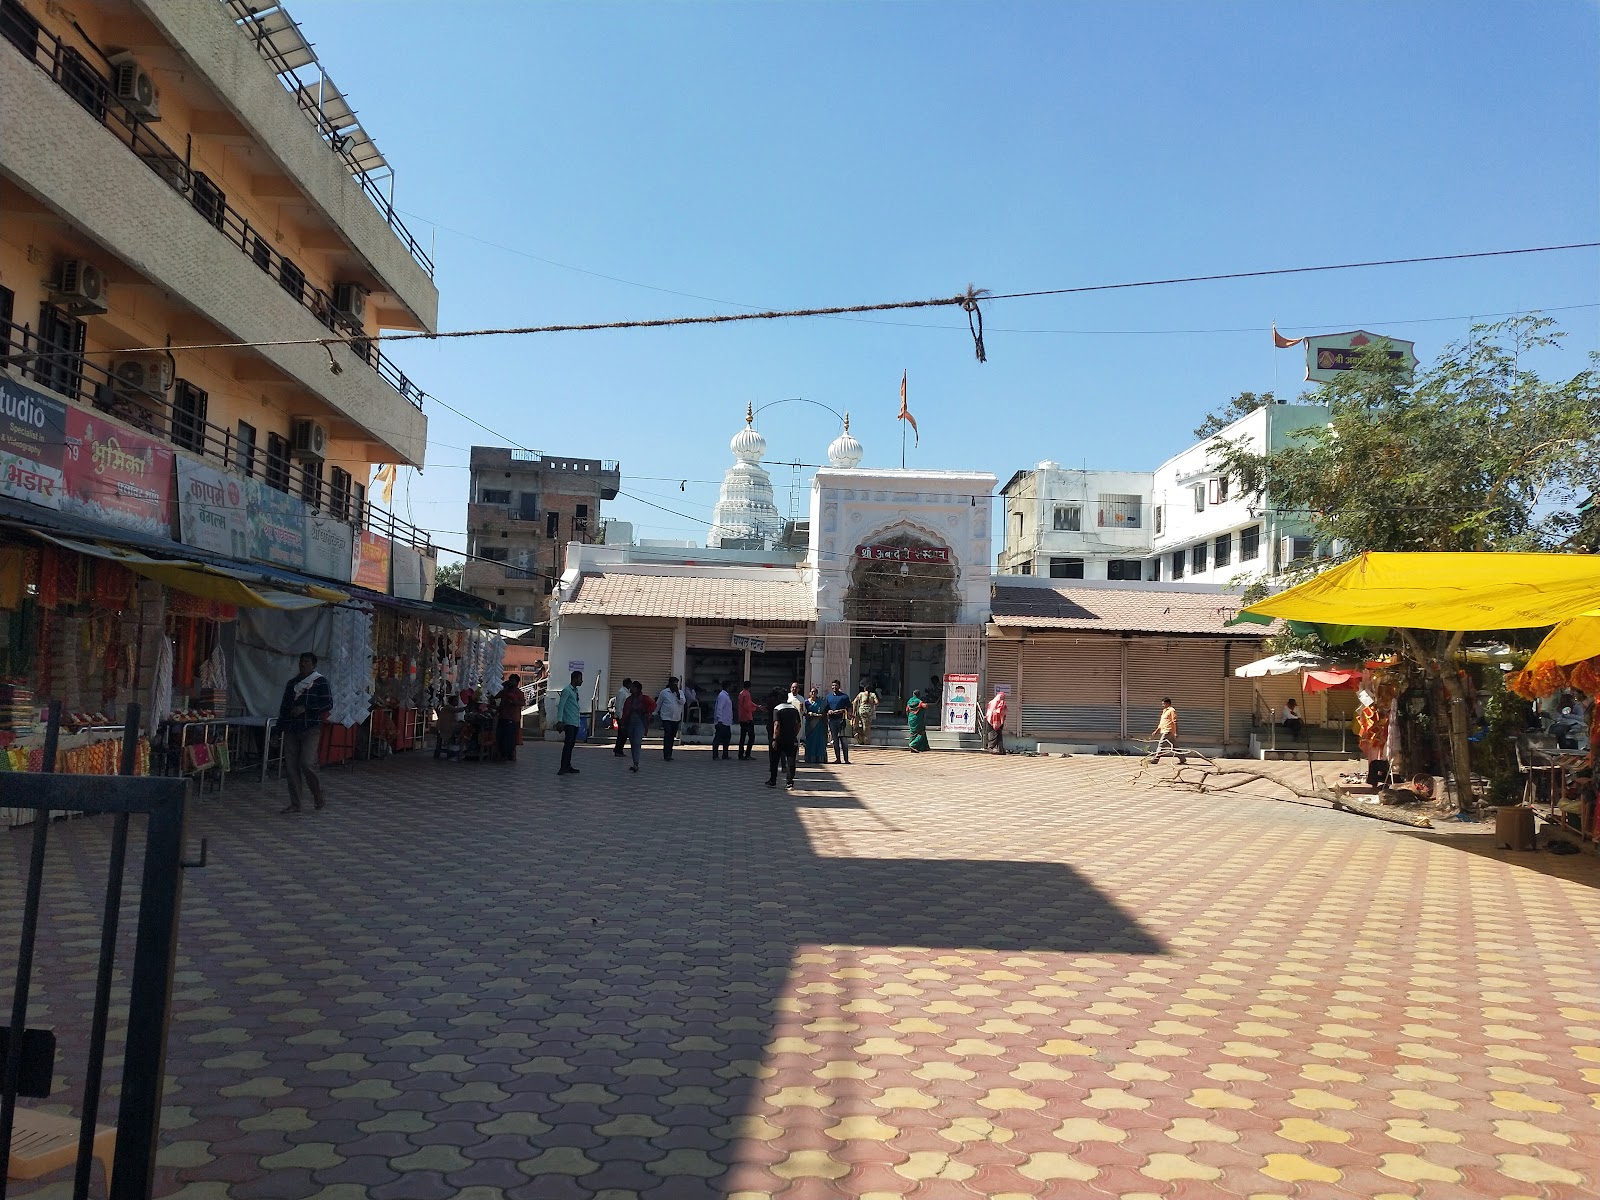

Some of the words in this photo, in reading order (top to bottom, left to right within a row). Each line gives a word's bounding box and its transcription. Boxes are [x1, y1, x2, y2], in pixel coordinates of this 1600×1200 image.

[9, 422, 40, 441] Specialist
[39, 433, 45, 442] in
[67, 445, 79, 461] 19
[8, 460, 54, 496] भंडार
[189, 477, 225, 507] कापसे
[861, 547, 872, 559] श्री
